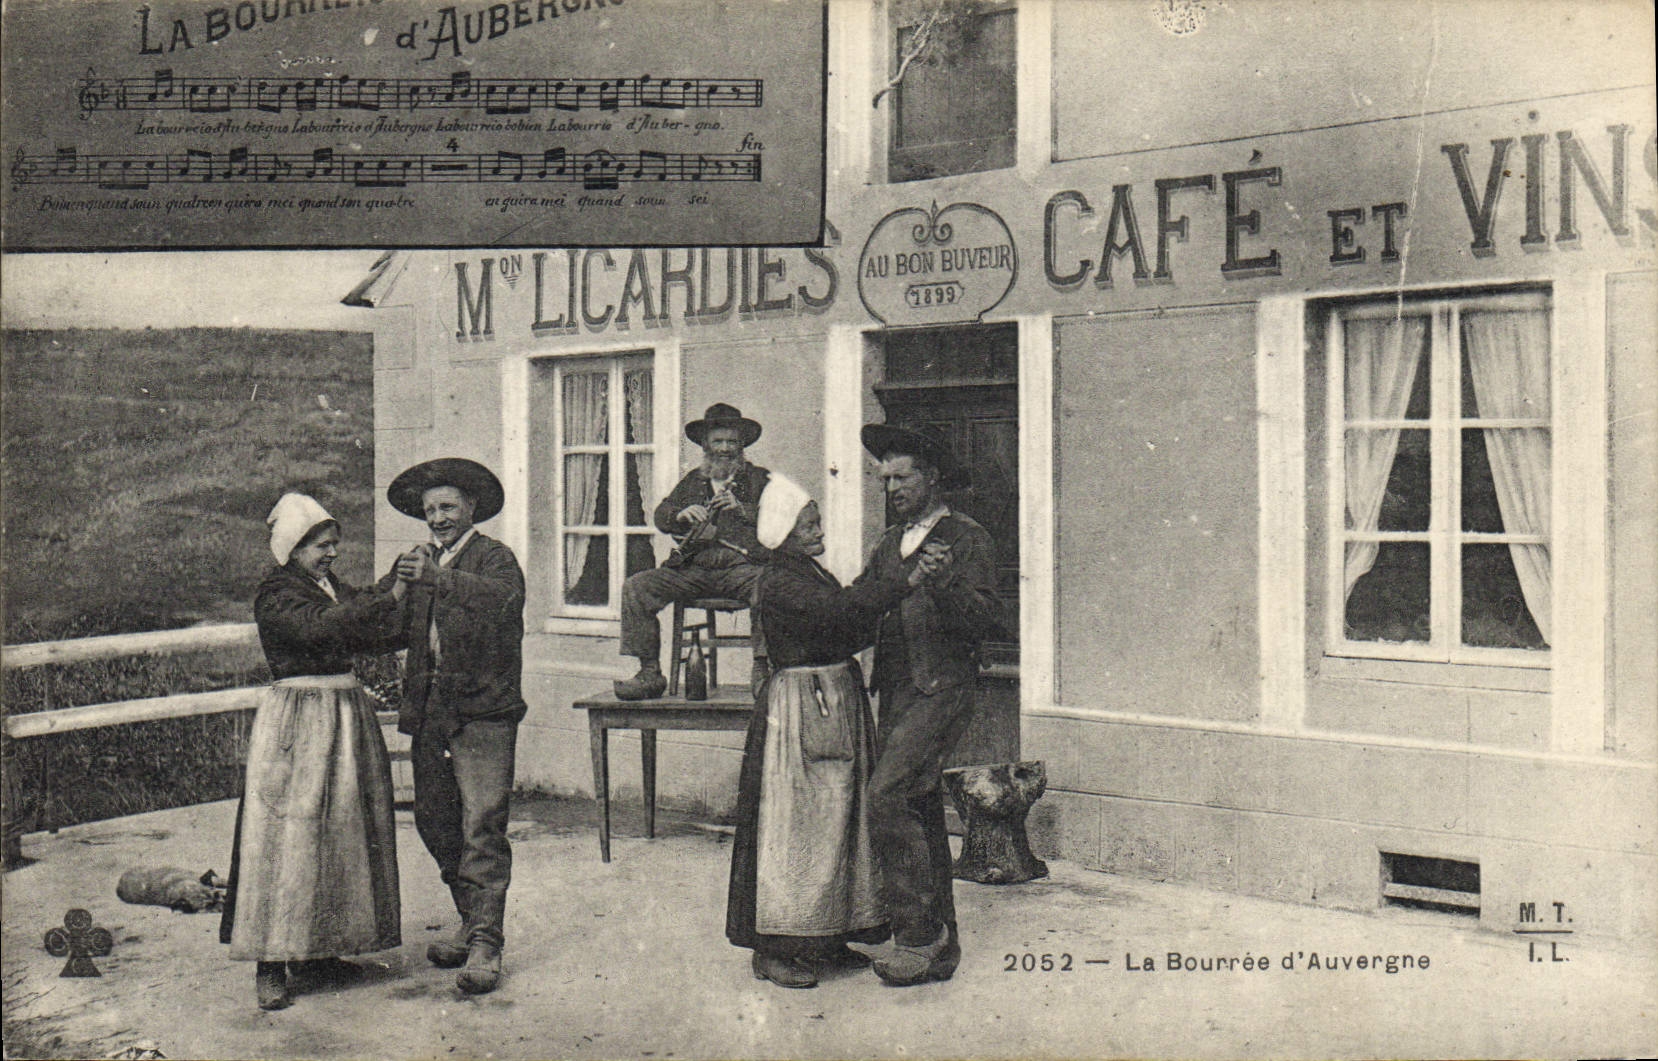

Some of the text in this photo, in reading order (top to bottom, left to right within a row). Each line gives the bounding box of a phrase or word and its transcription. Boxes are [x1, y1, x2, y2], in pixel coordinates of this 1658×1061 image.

[1043, 149, 1282, 291] CAFÉ
[1328, 202, 1408, 264] ET
[865, 245, 1013, 279] AU BON BUVEUR
[910, 287, 956, 306] 1899
